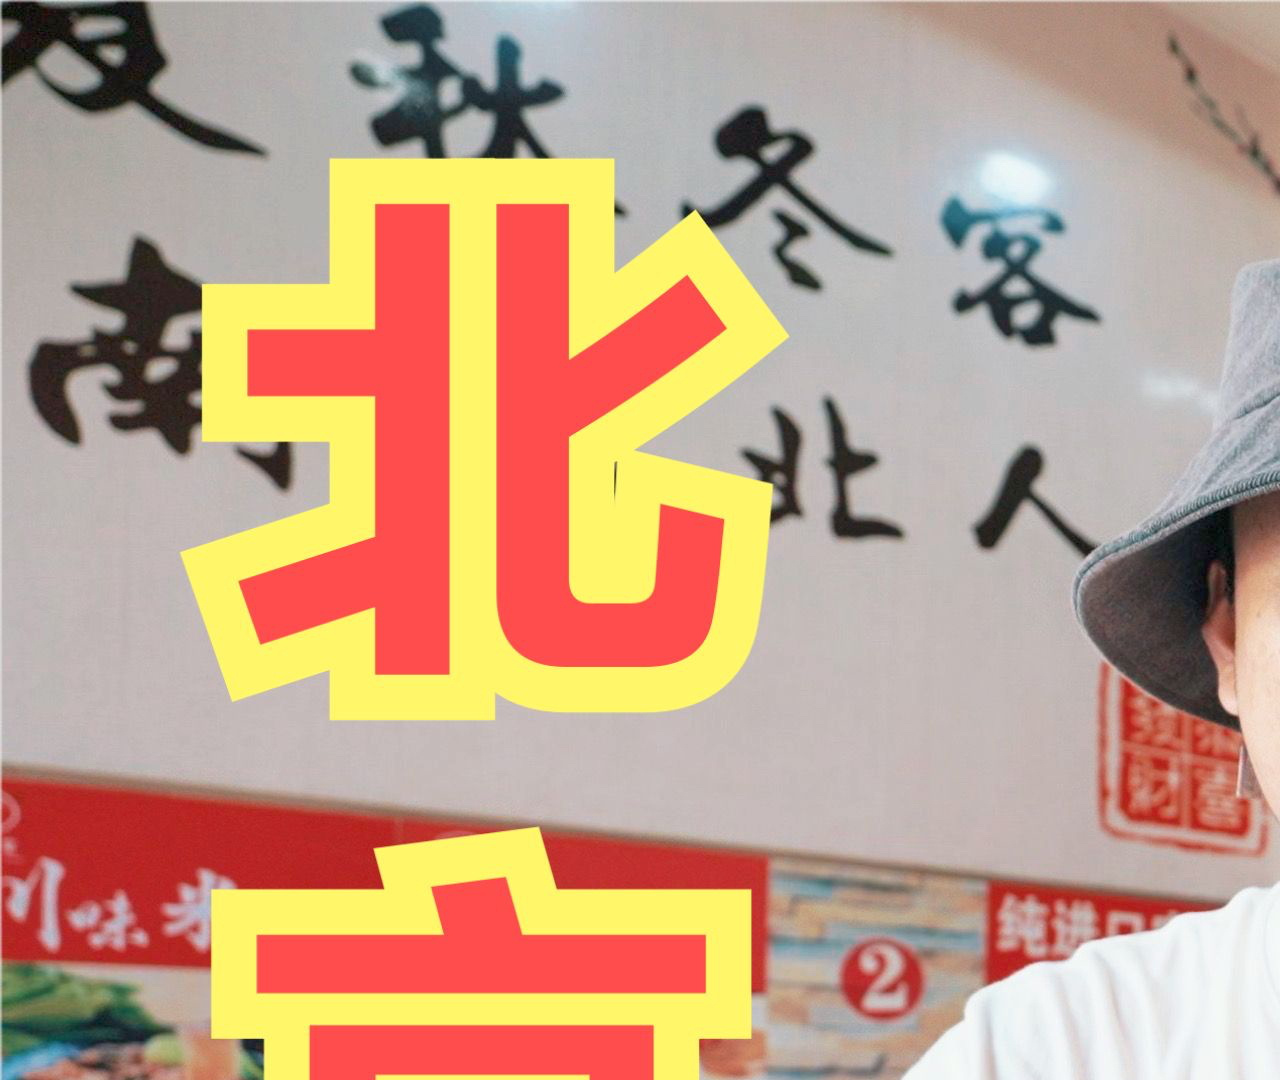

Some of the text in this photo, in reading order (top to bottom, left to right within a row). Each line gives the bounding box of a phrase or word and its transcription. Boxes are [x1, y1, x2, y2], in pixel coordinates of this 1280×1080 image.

[996, 893, 1180, 957] 纯进口
[858, 945, 911, 1010] 2
